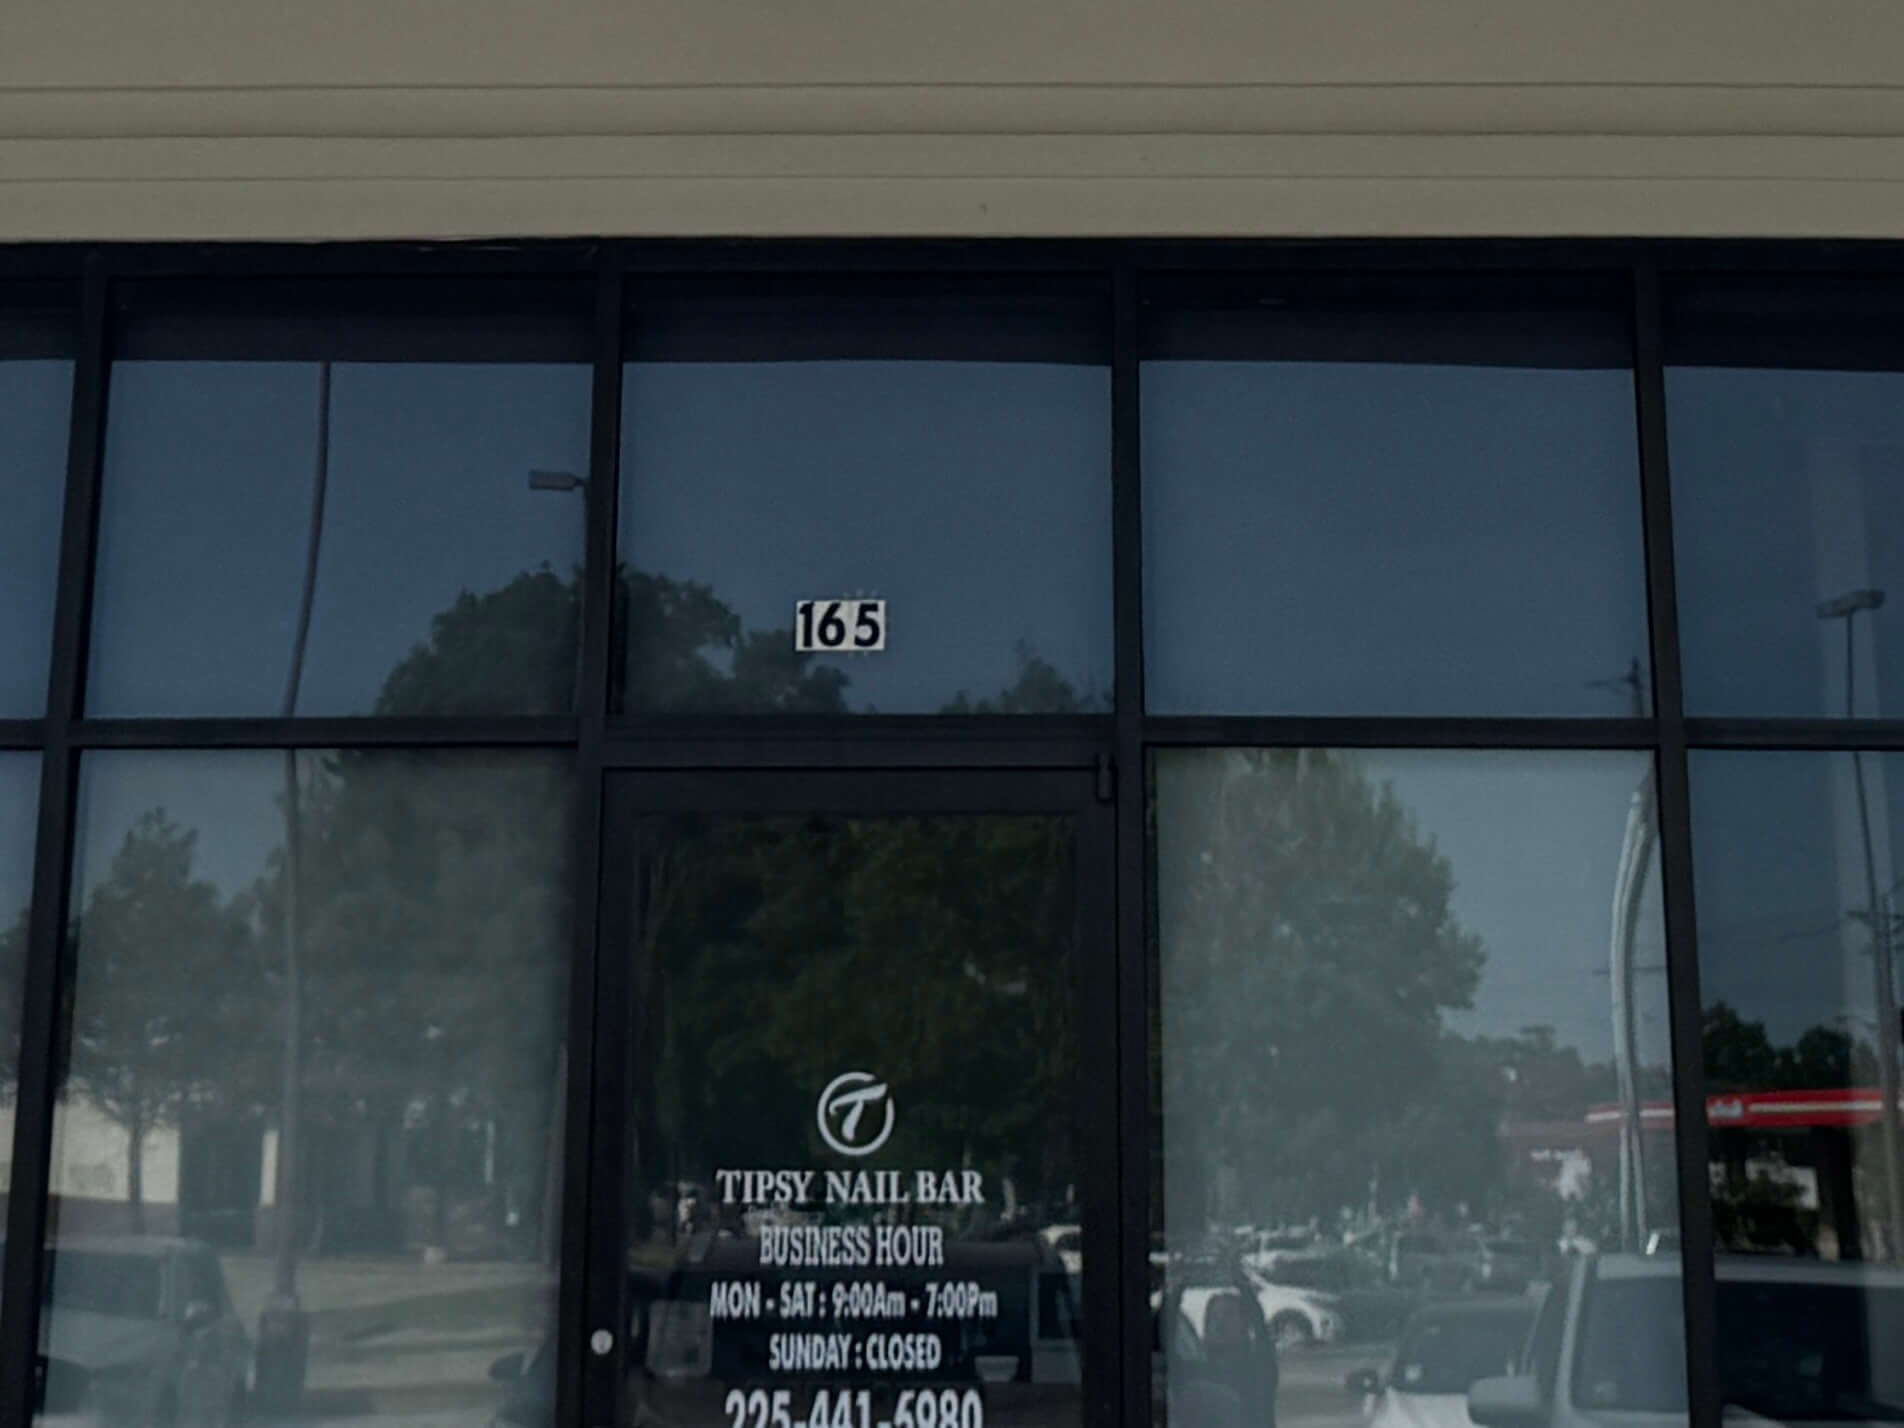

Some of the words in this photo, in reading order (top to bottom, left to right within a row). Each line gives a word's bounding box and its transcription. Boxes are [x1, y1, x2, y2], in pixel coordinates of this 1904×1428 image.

[799, 602, 880, 648] 165
[716, 1170, 813, 1204] TIPSY
[825, 1170, 909, 1204] NAIL
[916, 1170, 984, 1204] BAR
[759, 1225, 871, 1265] BUSINESS
[875, 1225, 944, 1265] HOUR
[709, 1281, 760, 1318] MON
[831, 1281, 906, 1318] 9:00Am
[925, 1281, 998, 1318] 7:00Pm
[866, 1333, 942, 1370] CLOSED
